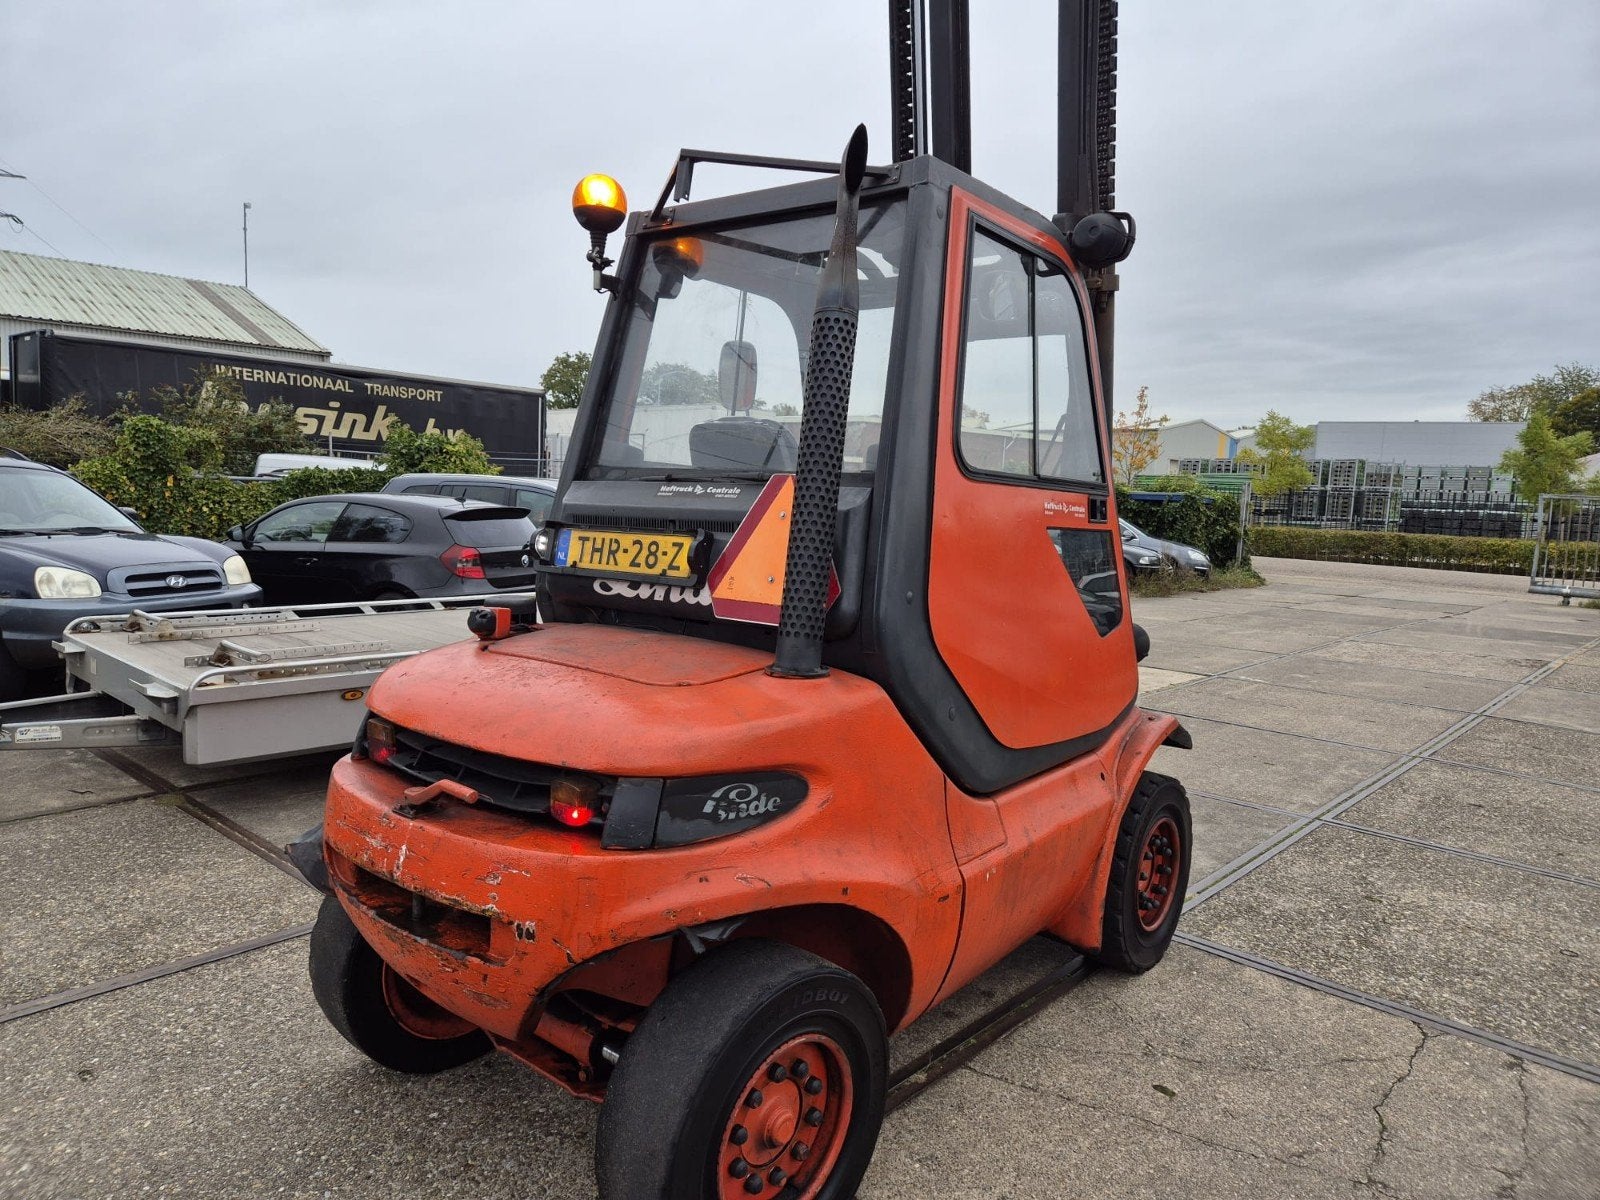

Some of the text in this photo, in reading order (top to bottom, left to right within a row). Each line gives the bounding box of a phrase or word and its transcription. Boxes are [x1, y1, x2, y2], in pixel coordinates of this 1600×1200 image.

[215, 364, 443, 402] INTERNATIONAAL TRANSPORT
[706, 486, 741, 494] Centrale
[557, 551, 566, 560] NL
[577, 535, 684, 571] THR-28-Z
